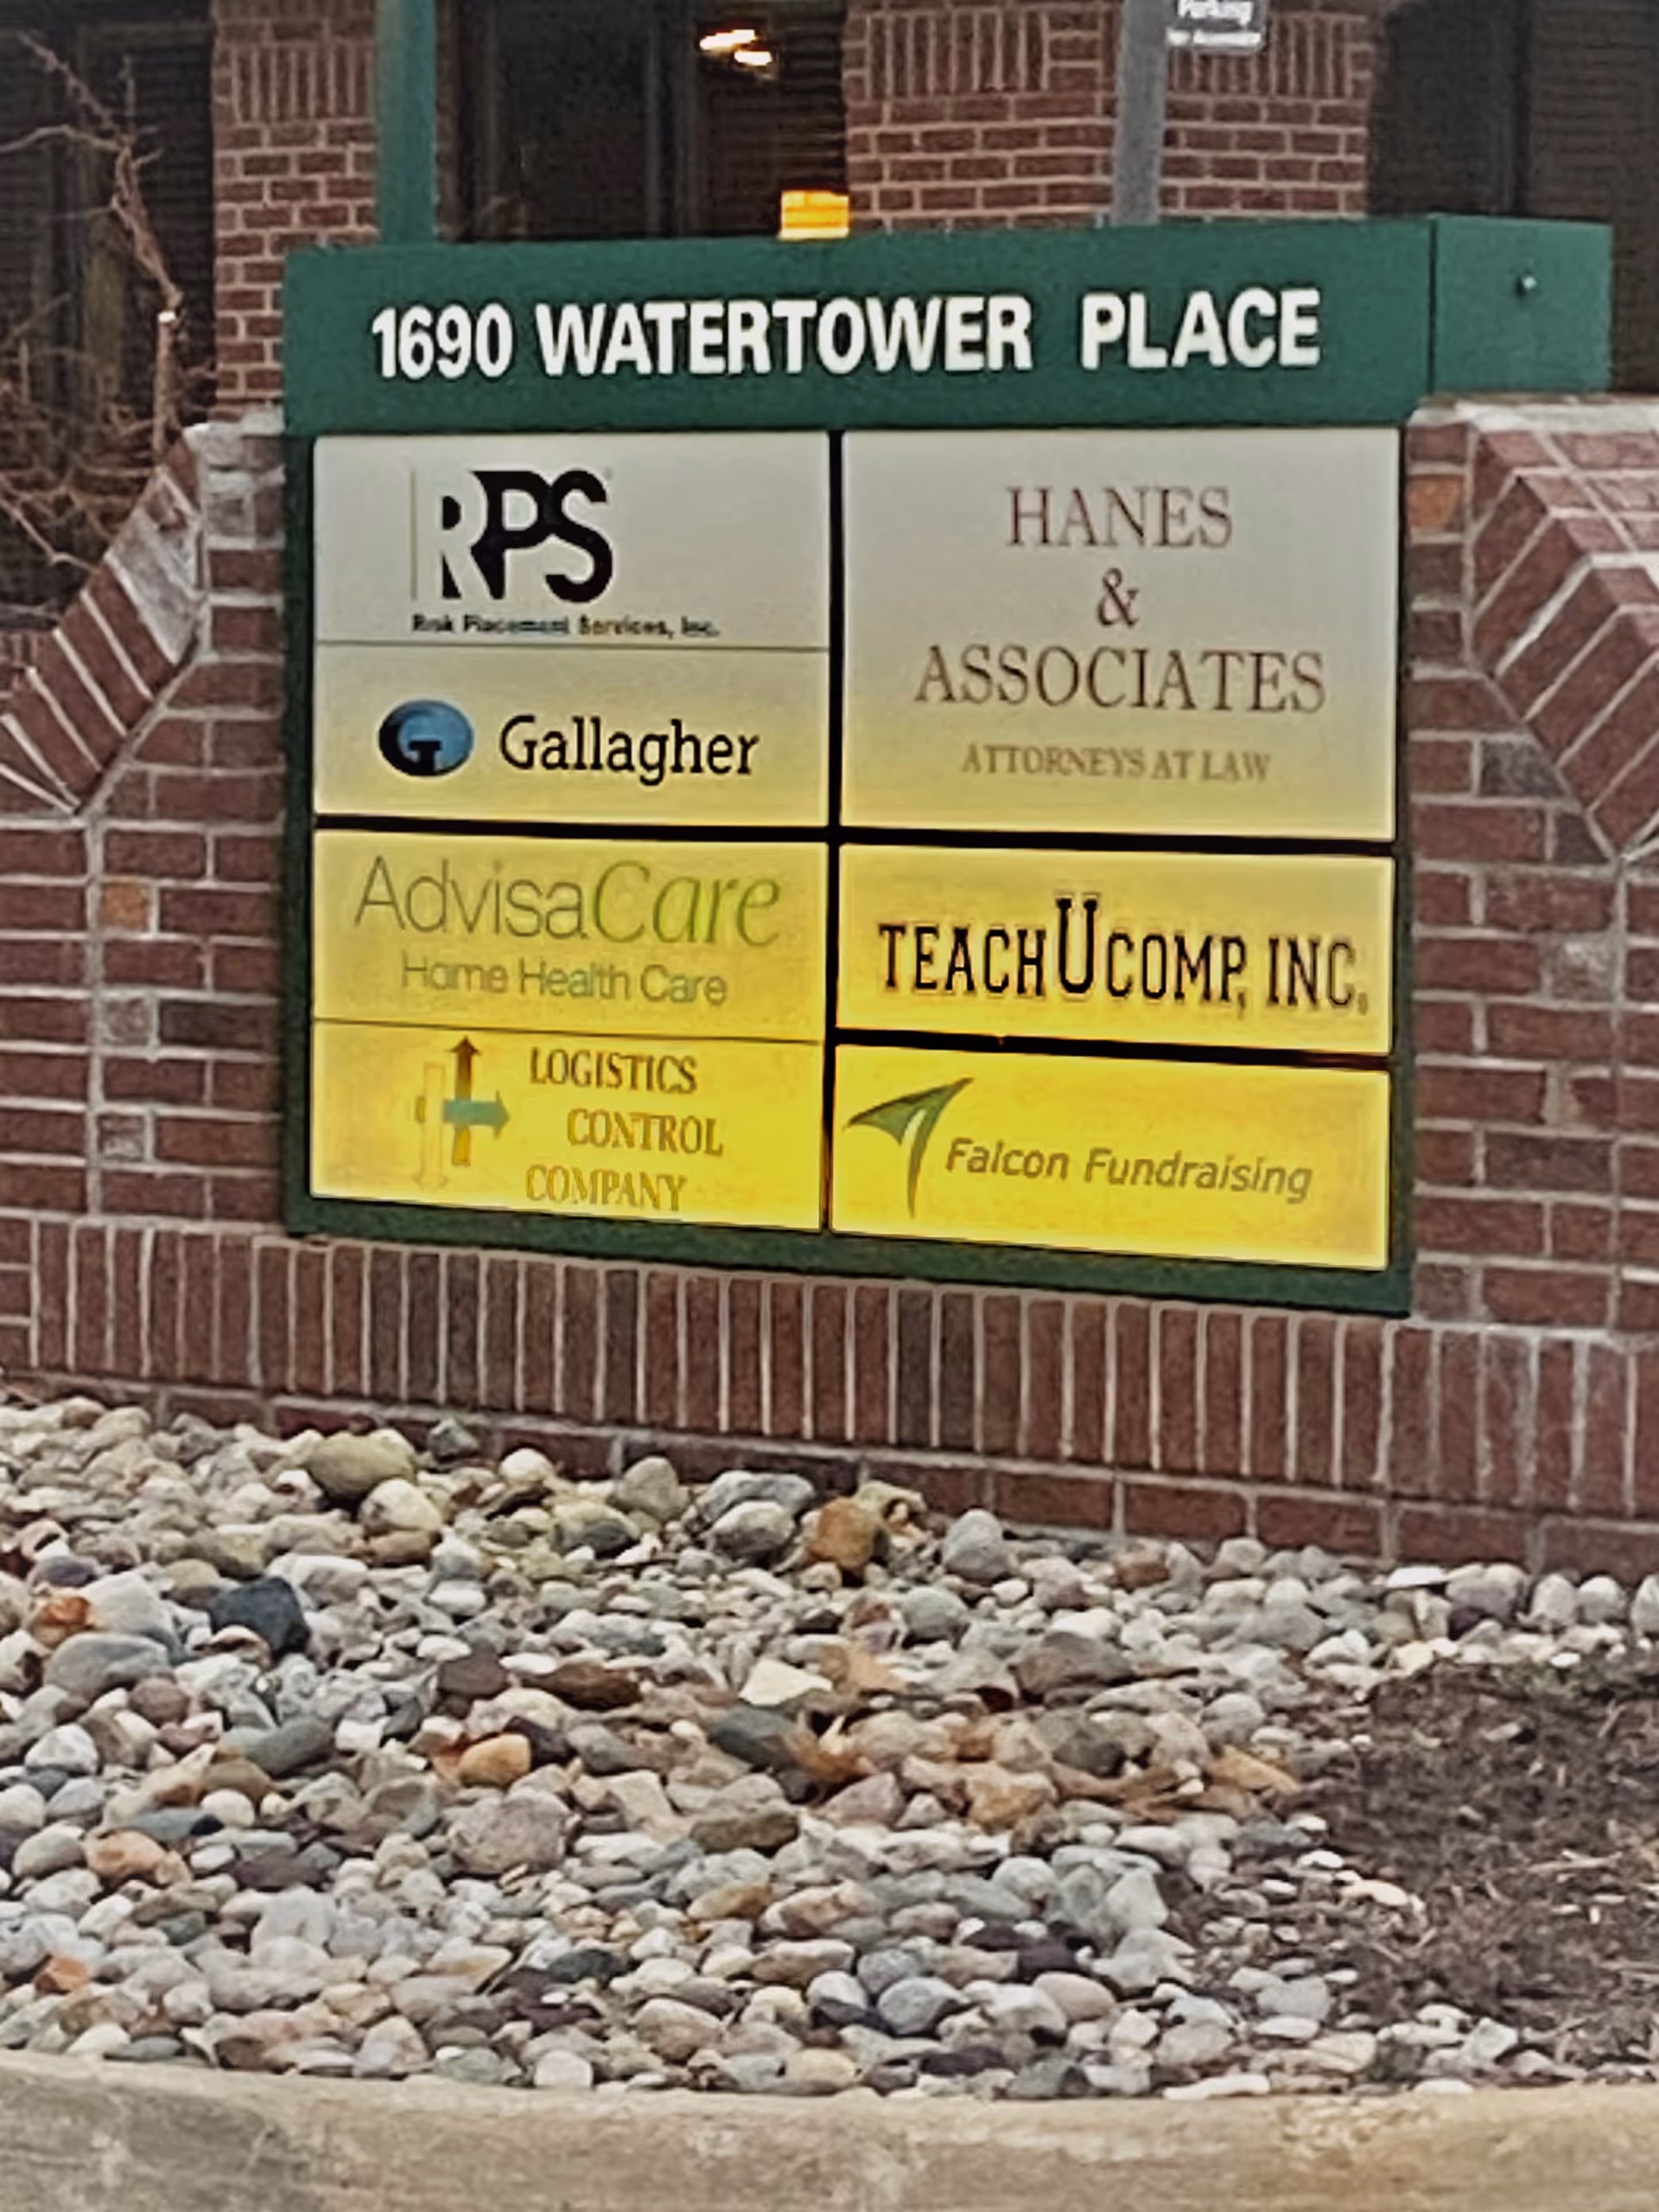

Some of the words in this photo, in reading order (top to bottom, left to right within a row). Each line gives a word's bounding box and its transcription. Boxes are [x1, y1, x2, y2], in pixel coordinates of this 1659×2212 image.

[372, 302, 513, 380] 1690
[535, 296, 1033, 378] WATERTOWER
[1080, 288, 1320, 370] PLACE
[440, 468, 613, 603] RPS
[1006, 485, 1234, 548] HANES
[578, 614, 674, 639] Services,
[680, 616, 721, 637] Inc.
[1096, 566, 1141, 628] &
[913, 643, 1327, 714] ASSOCIATES
[499, 715, 760, 786] Gallagher
[962, 743, 1147, 778] ATTORNEYS
[1151, 749, 1195, 780] AT
[1200, 750, 1272, 783] LAW
[354, 855, 783, 948] AdvisaCare
[402, 950, 509, 994] Home
[518, 957, 629, 1001] Health
[639, 963, 728, 1007] Care
[1266, 935, 1369, 1014] INC.
[529, 1046, 699, 1094] LOGISTICS
[567, 1108, 724, 1157] CONTROL
[525, 1165, 688, 1212] COMPANY
[946, 1138, 1070, 1182] Falcon
[1084, 1147, 1314, 1205] Fundraising
